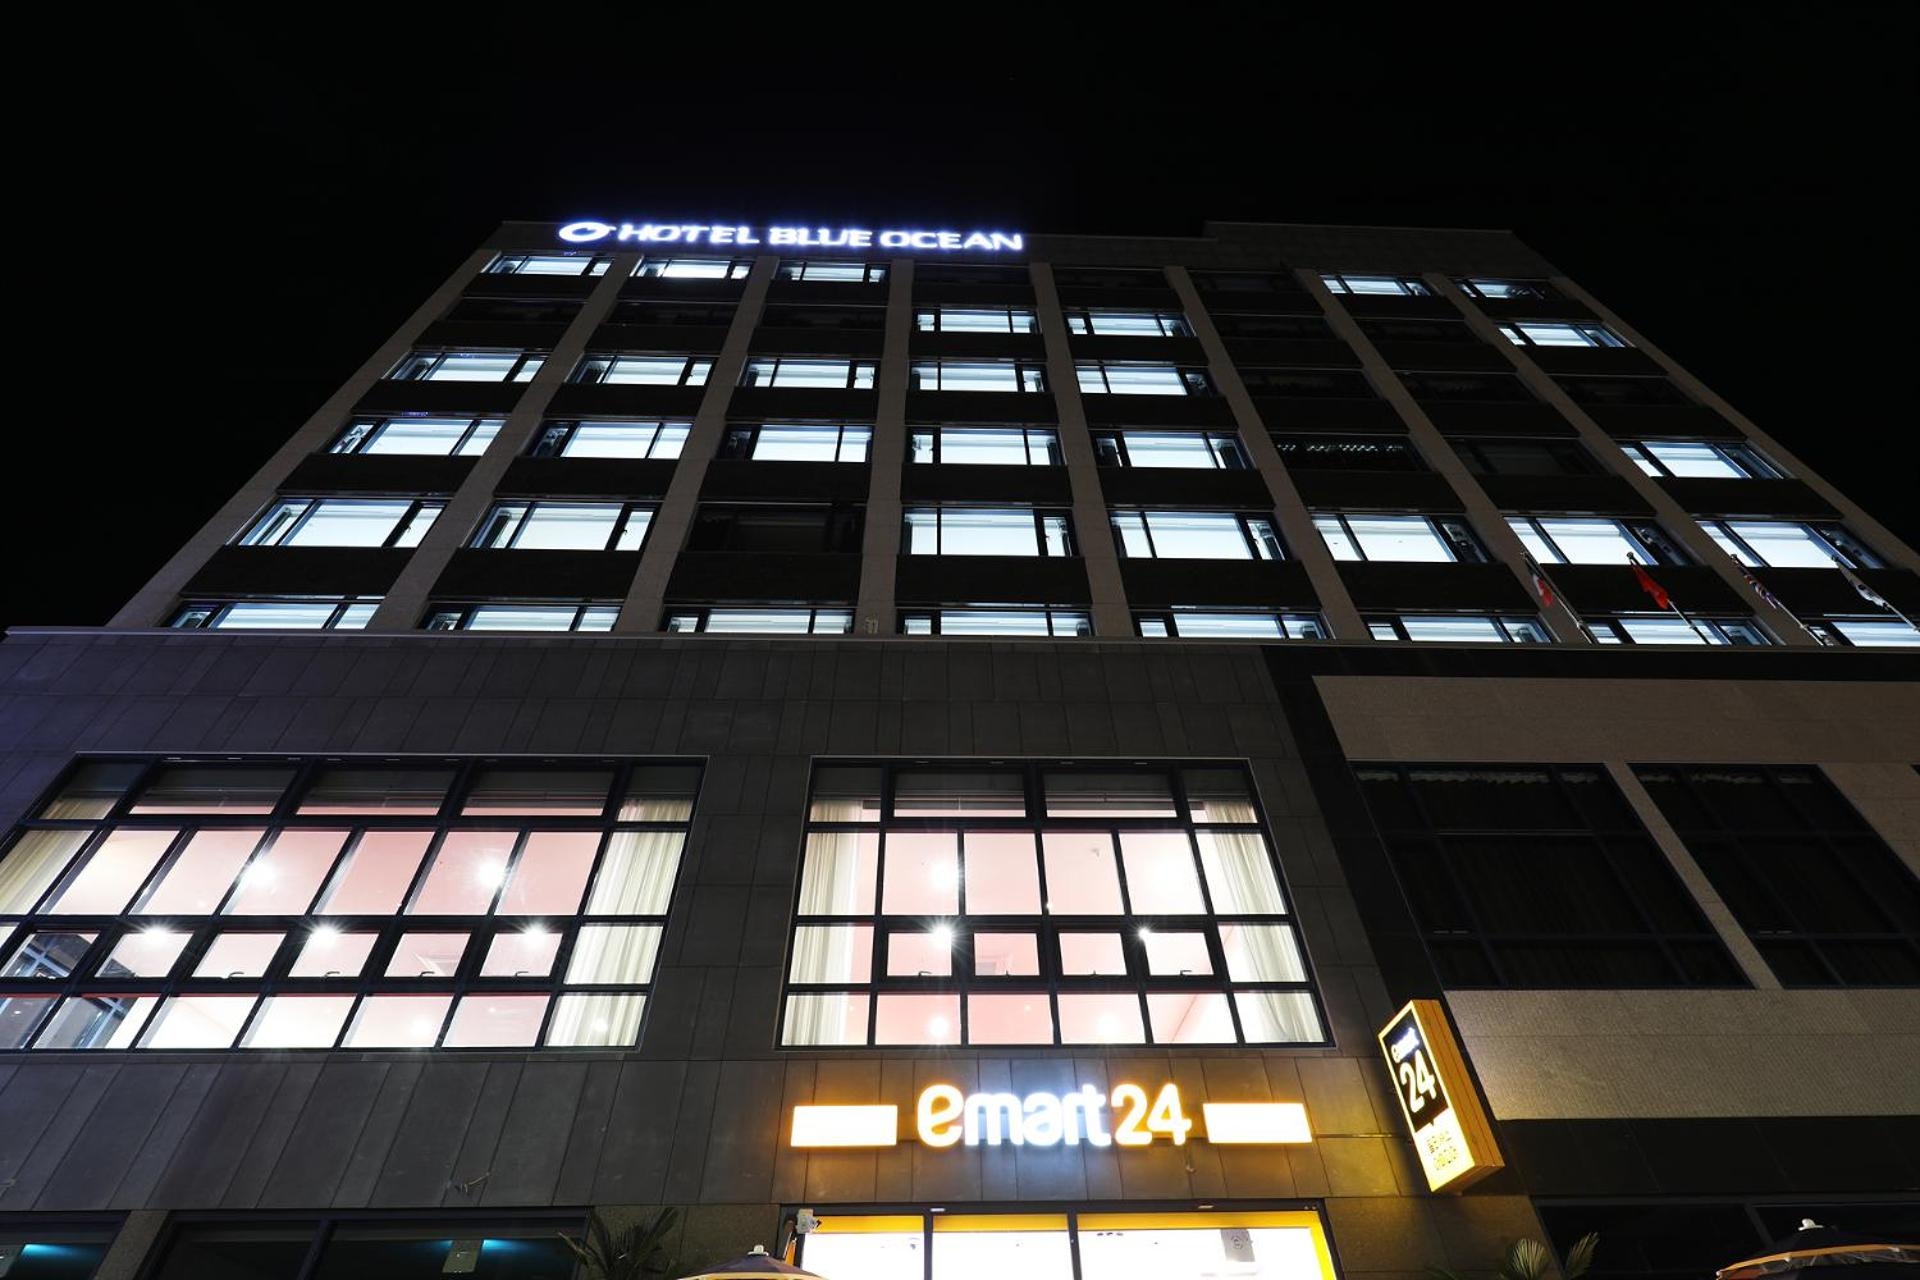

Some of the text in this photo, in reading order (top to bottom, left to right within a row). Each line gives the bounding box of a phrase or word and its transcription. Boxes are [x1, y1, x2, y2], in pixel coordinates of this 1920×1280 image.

[618, 223, 1023, 250] HOTEL BLUE OCEAN
[1400, 1049, 1436, 1113] 24
[916, 1083, 1192, 1147] emart24
